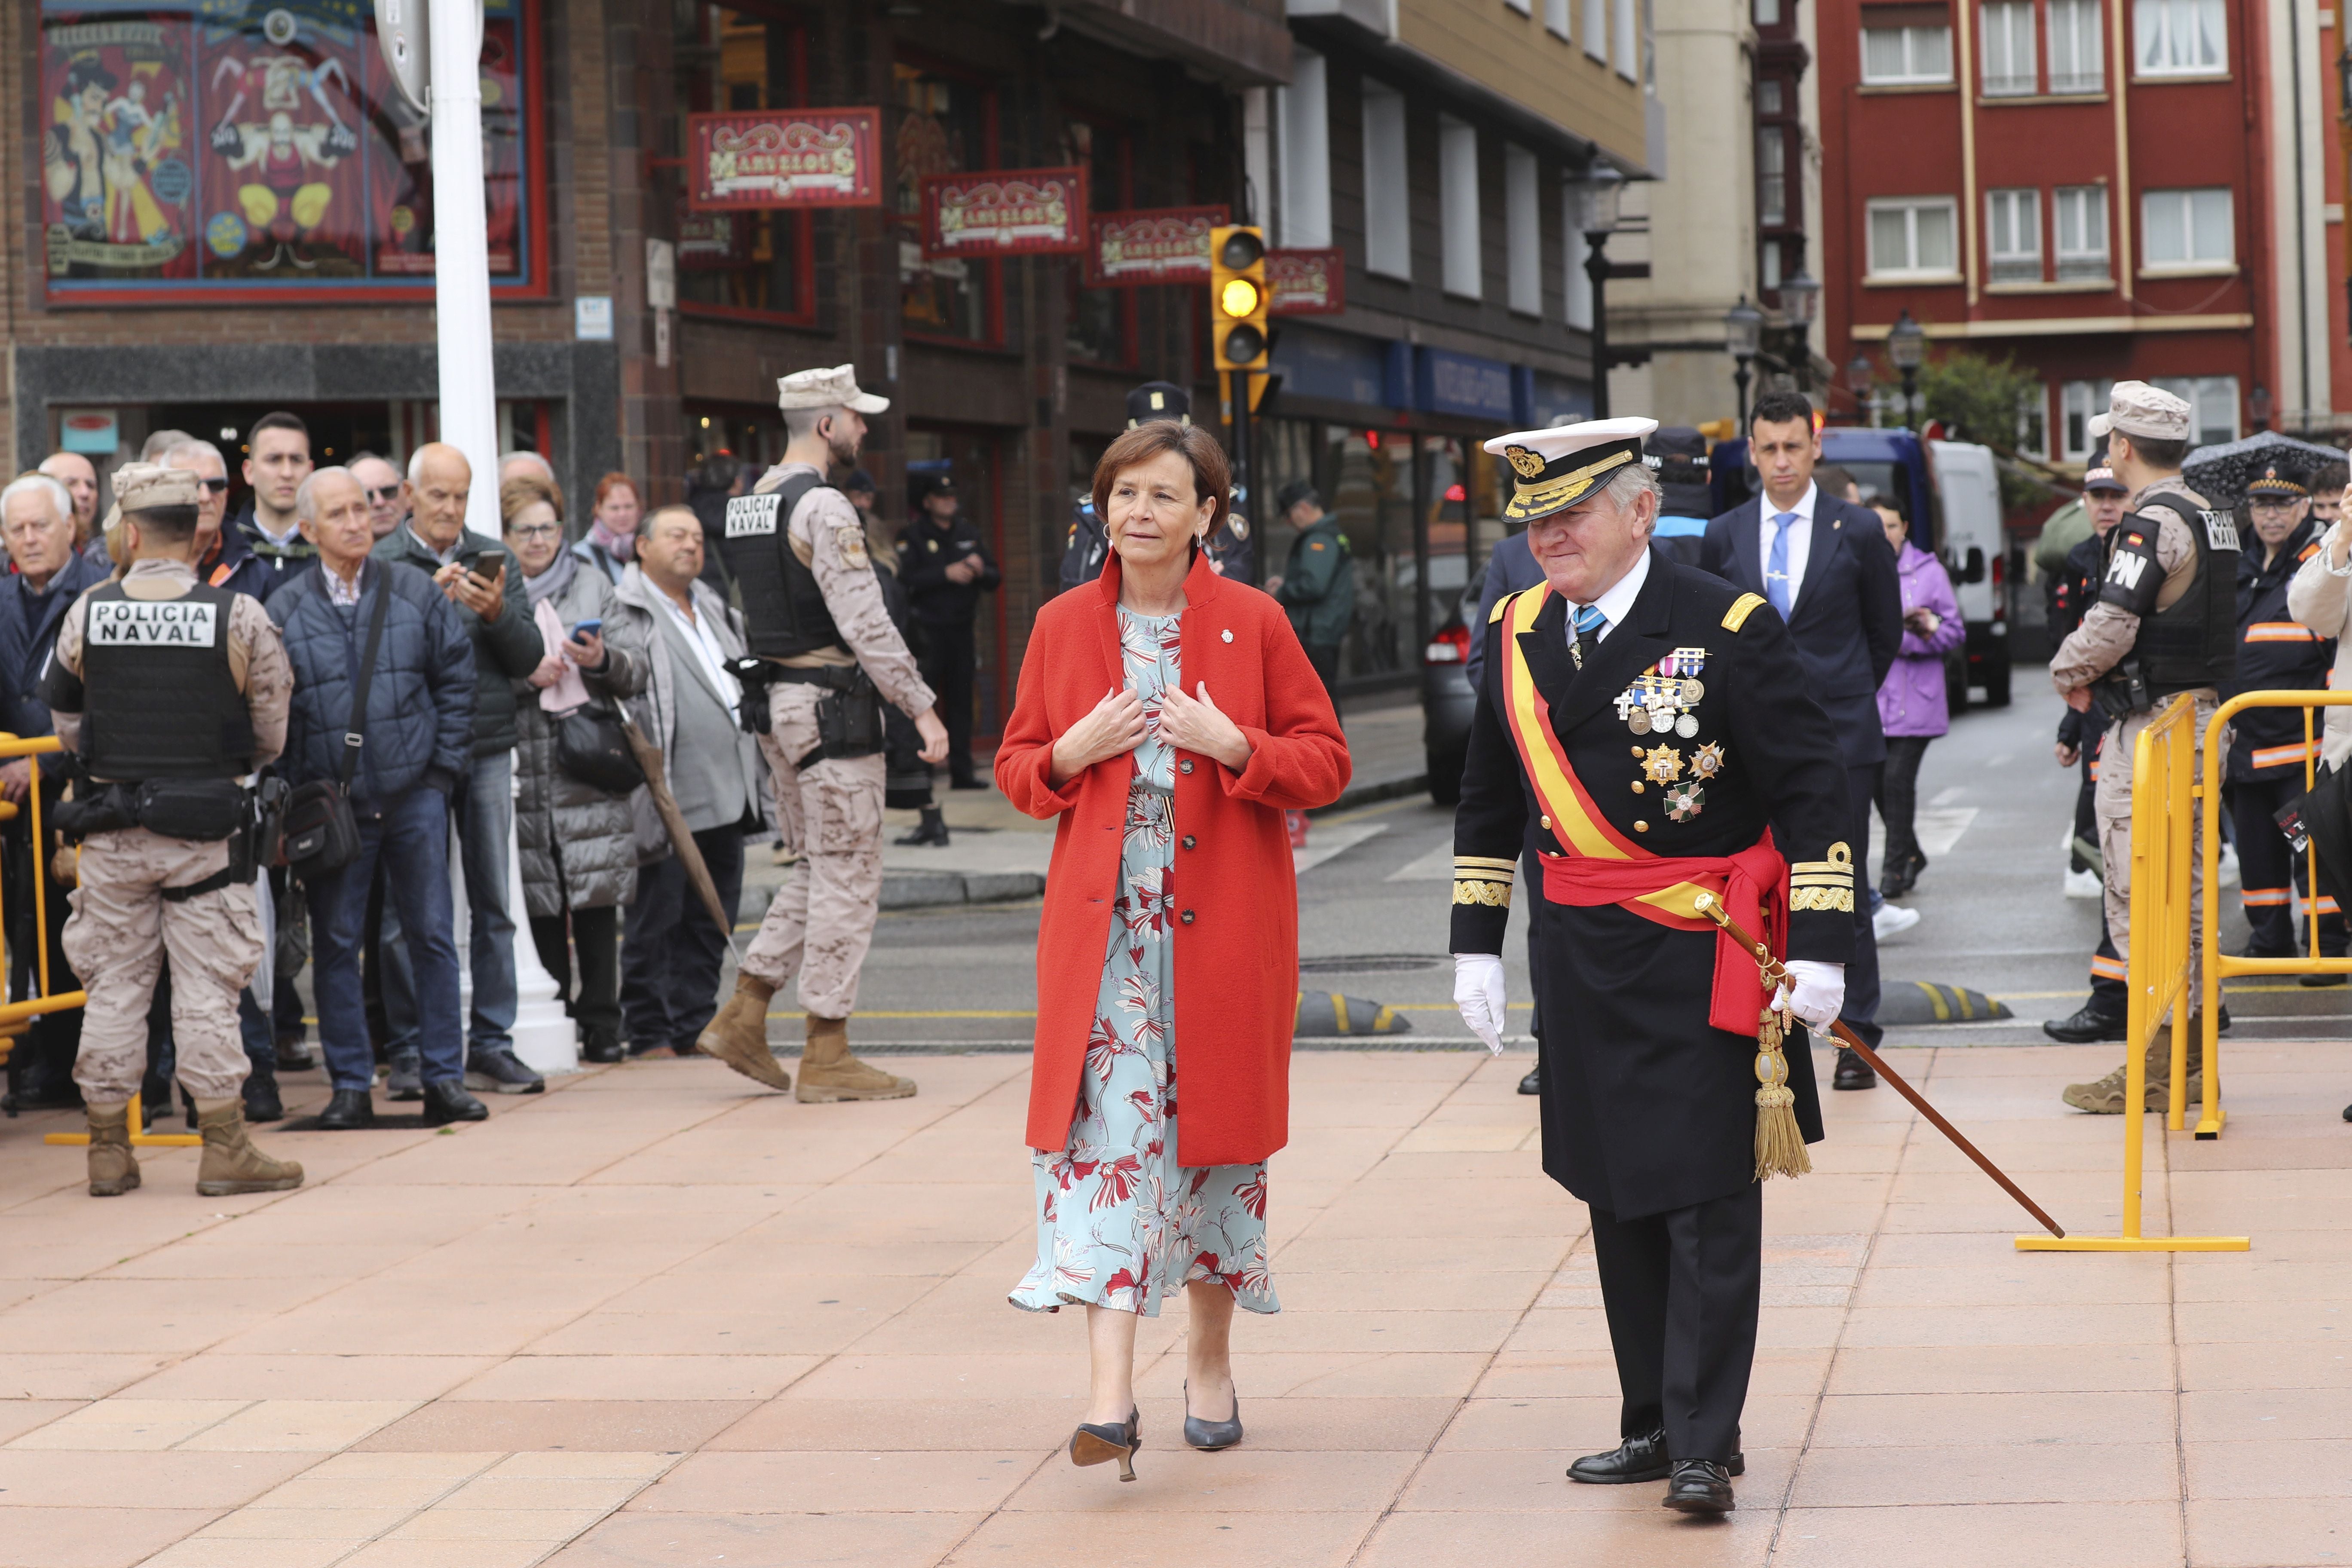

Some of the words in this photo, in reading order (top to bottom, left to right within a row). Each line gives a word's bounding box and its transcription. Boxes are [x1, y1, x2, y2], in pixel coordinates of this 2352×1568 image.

[729, 497, 773, 514] POLICIA
[730, 514, 769, 531] NAVAL
[2105, 549, 2147, 590] PN
[97, 605, 207, 622] POLICIA
[102, 625, 201, 641] NAVAL
